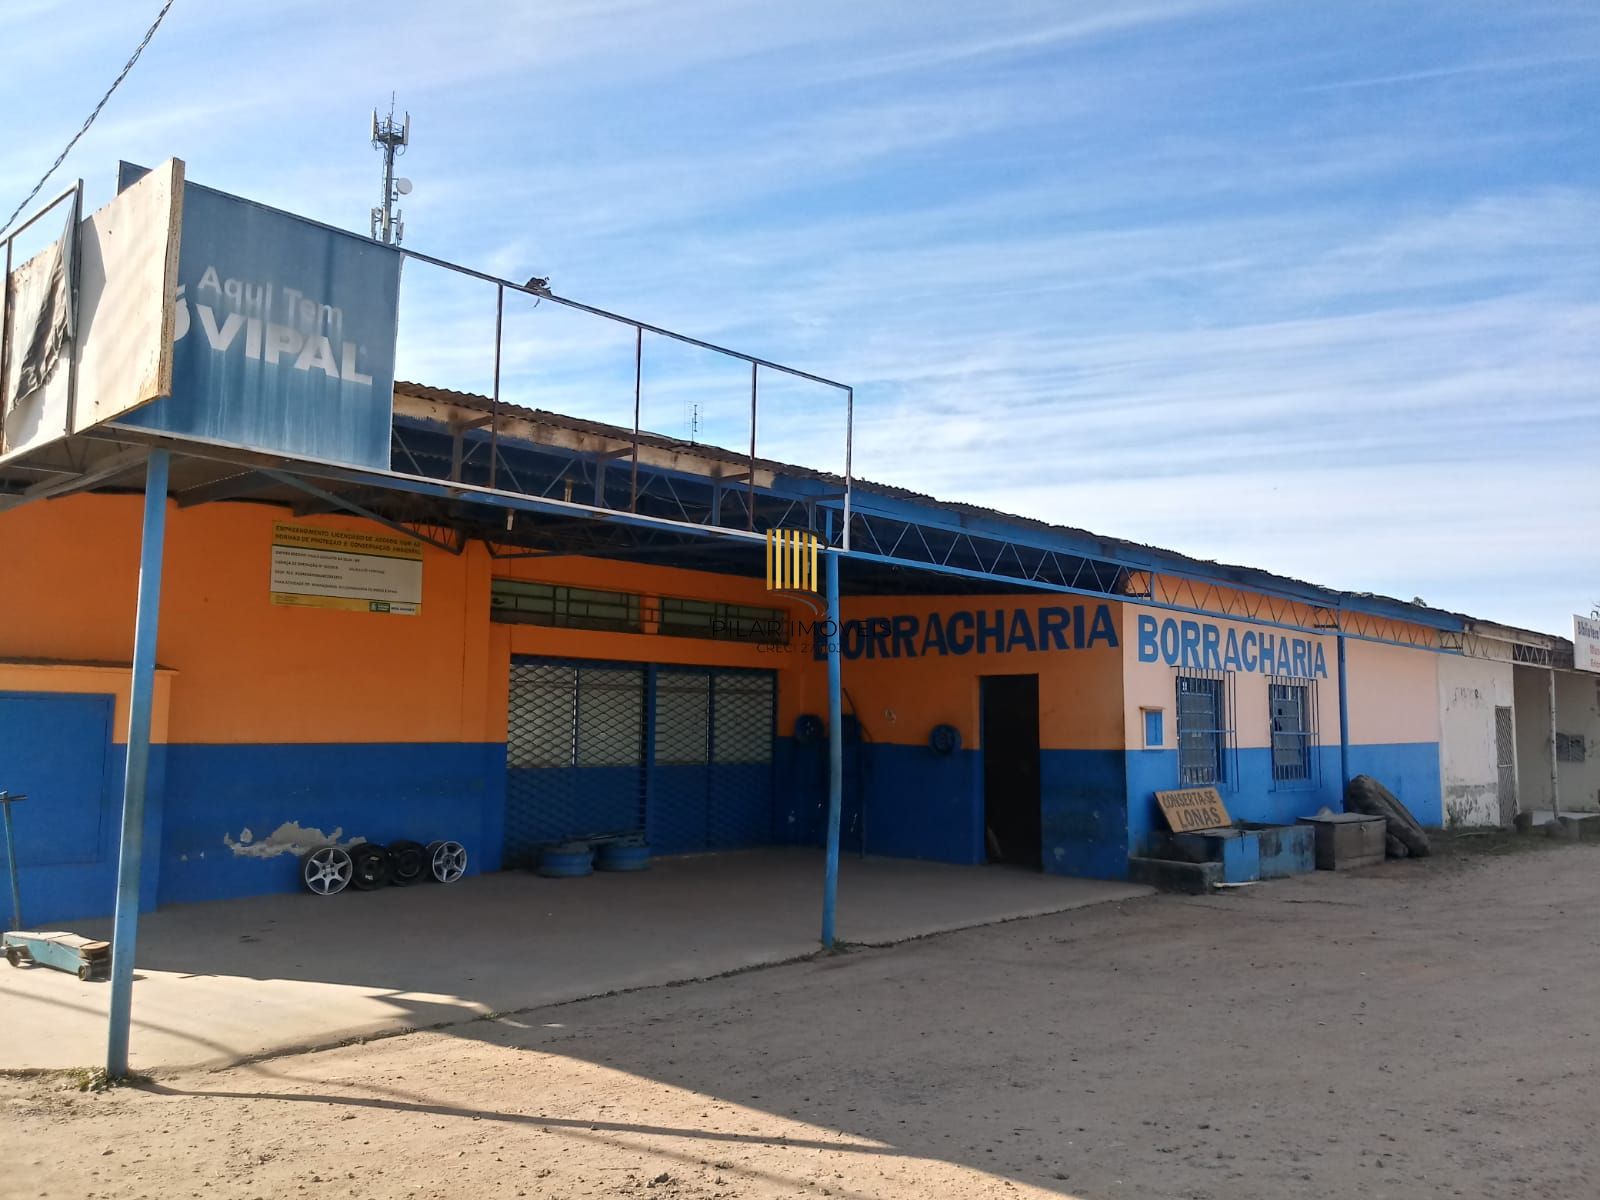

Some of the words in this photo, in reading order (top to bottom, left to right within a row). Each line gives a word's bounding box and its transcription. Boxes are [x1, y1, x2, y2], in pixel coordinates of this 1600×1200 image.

[283, 287, 343, 326] Tem
[195, 303, 373, 385] VIPAL
[813, 604, 1120, 661] BORRACHARIA
[1137, 614, 1328, 678] BORRACHARIA
[1175, 806, 1221, 828] LONAS
